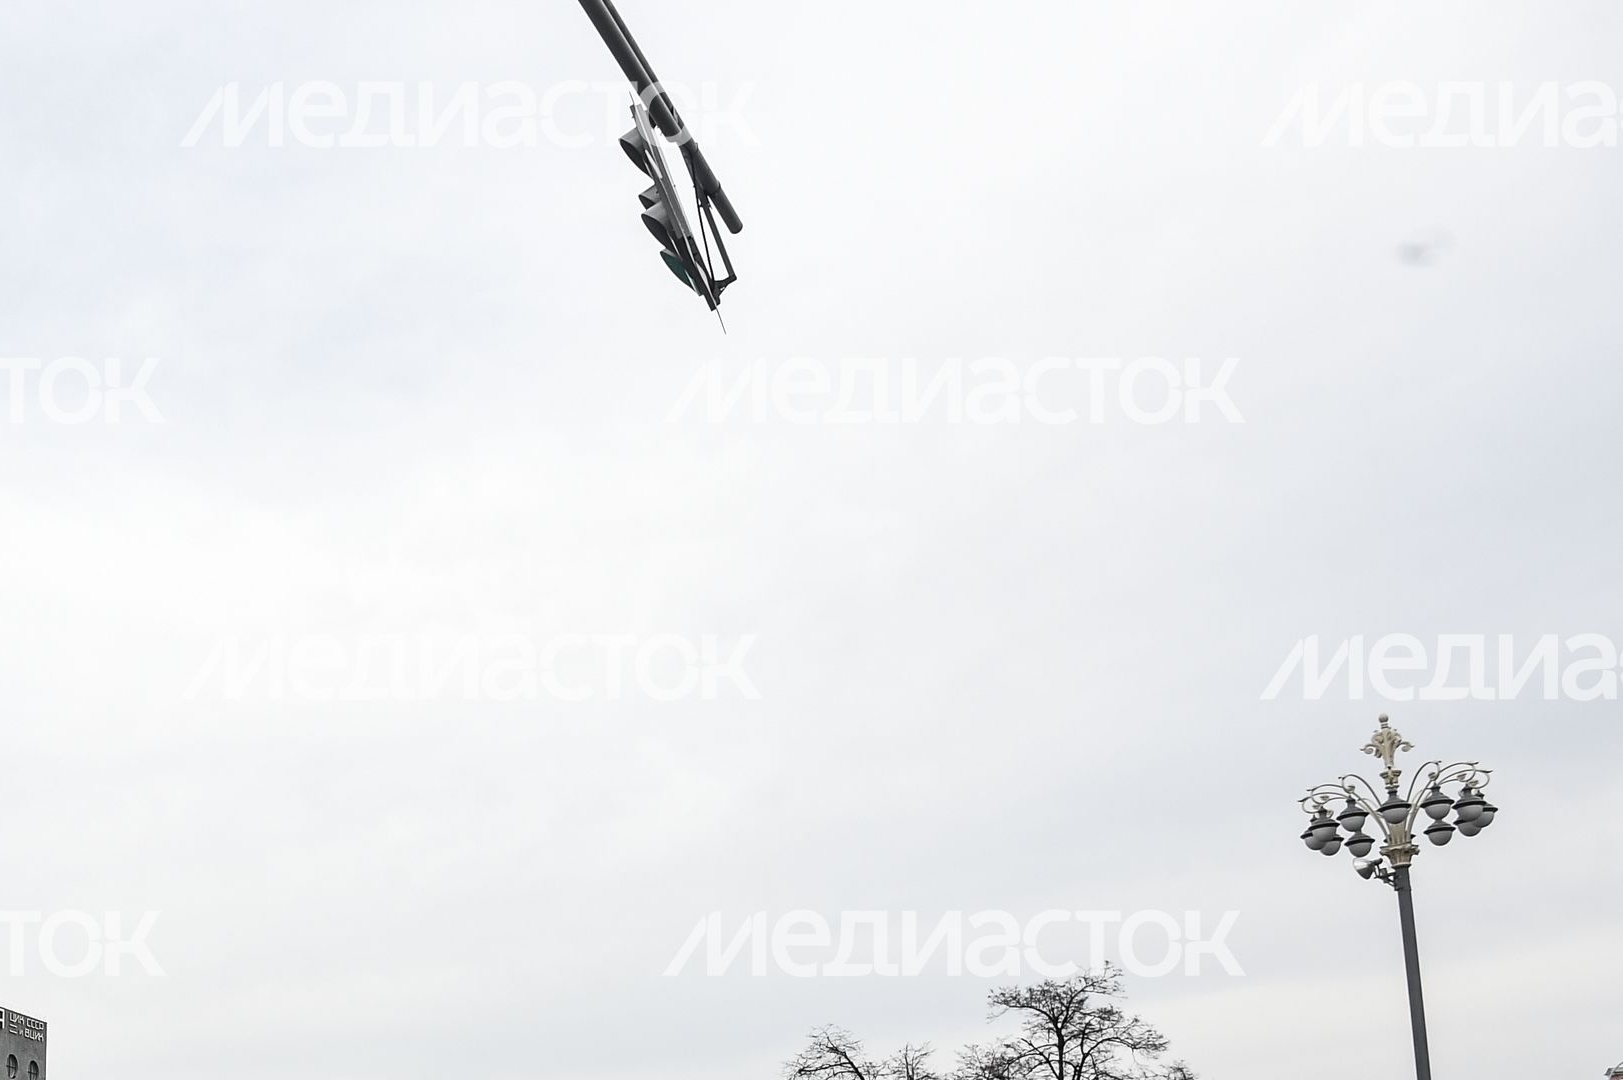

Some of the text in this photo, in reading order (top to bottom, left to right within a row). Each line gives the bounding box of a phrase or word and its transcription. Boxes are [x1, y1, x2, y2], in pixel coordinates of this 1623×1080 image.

[9, 1012, 44, 1030] ЦИК СССР
[25, 1028, 44, 1042] ВЦИК
